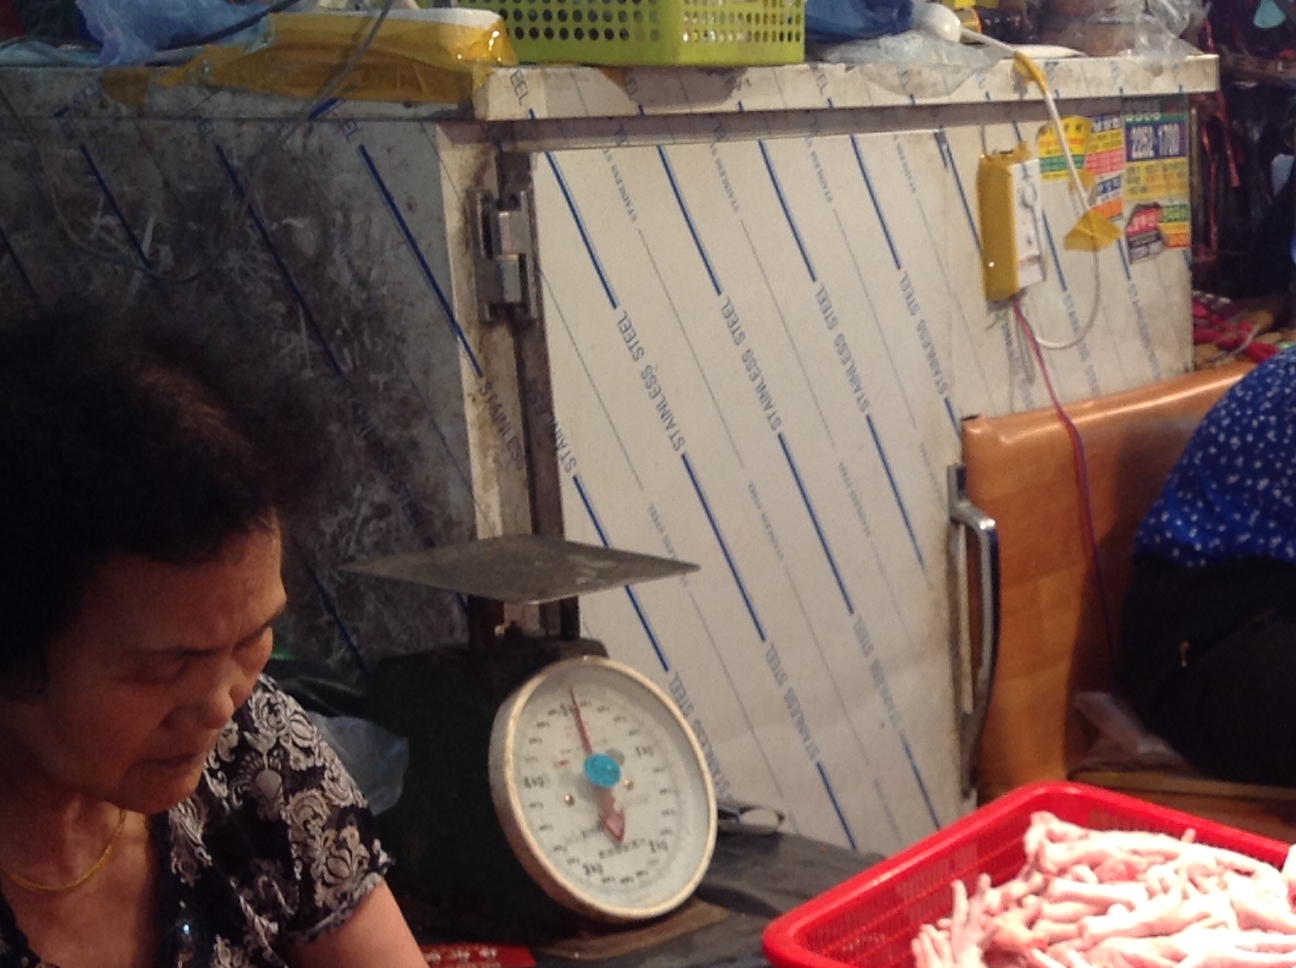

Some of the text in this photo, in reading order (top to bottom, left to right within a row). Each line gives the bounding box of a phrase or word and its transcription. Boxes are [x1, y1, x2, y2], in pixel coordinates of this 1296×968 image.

[720, 296, 783, 432] STAINLESS STEEL
[815, 283, 840, 331] STEEL
[616, 310, 686, 452] STAINLESS STEEL
